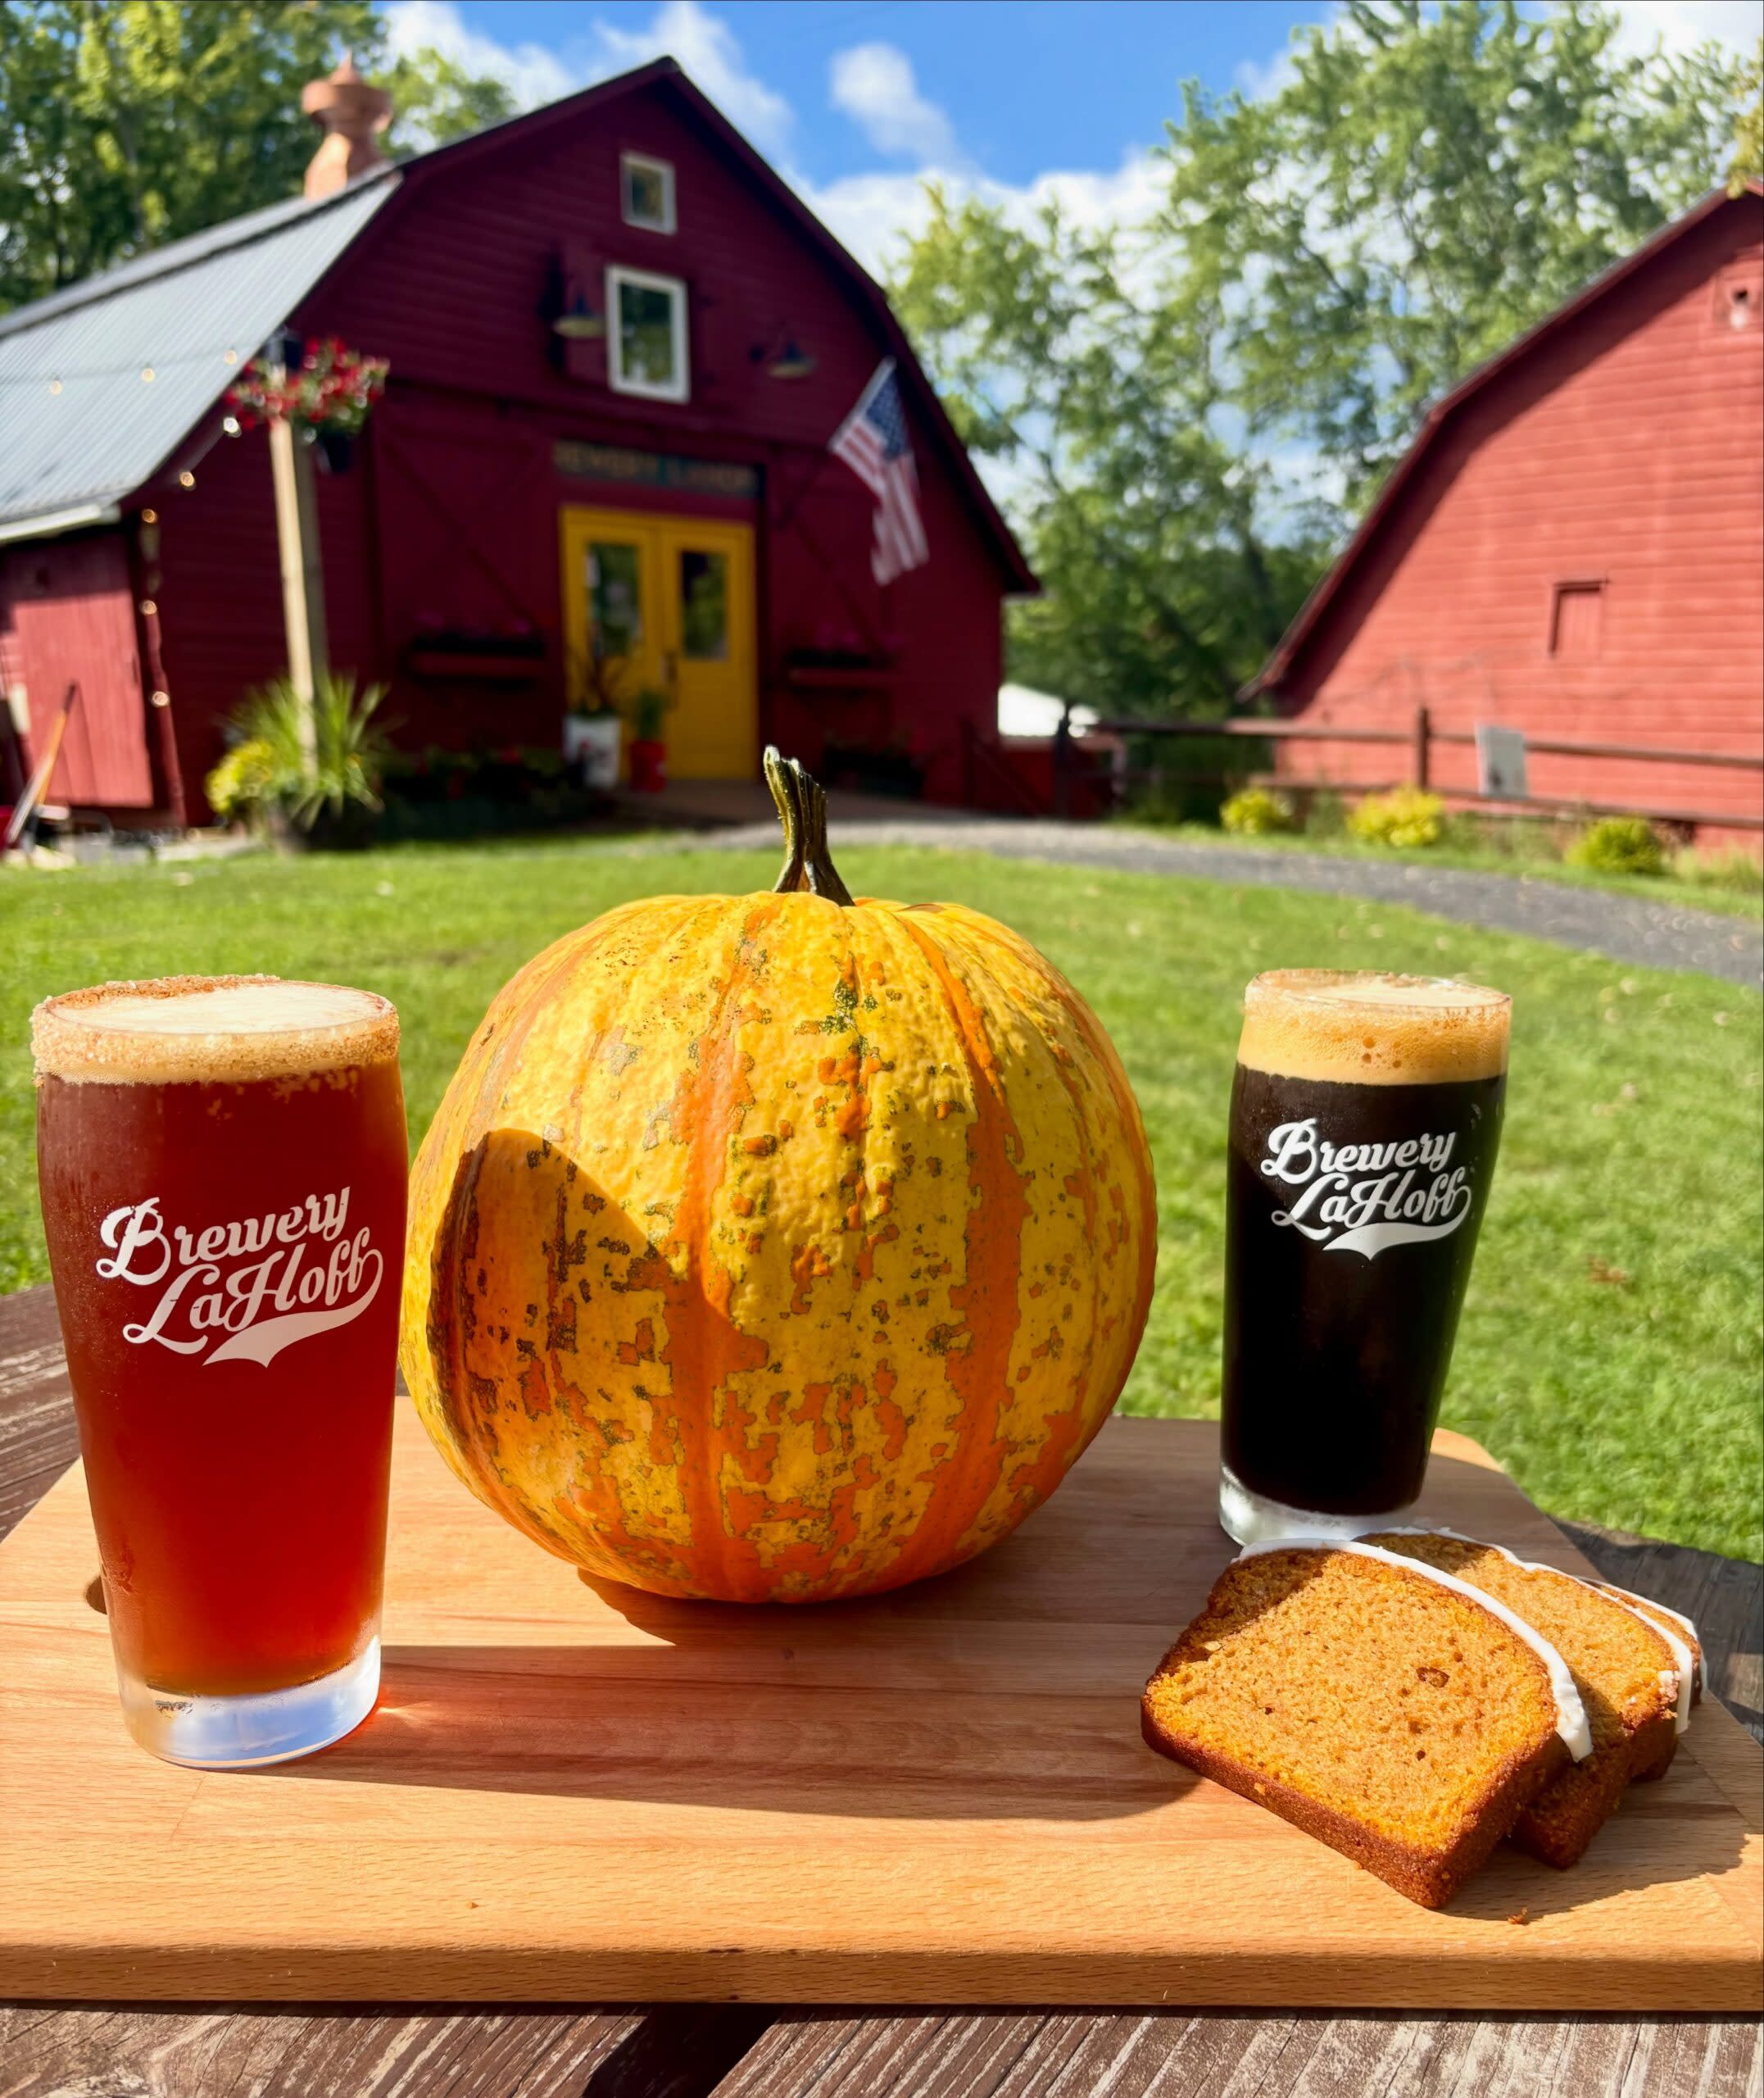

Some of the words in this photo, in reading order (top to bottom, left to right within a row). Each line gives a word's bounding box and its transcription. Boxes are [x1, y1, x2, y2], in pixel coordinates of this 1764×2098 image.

[1260, 1117, 1457, 1184] Brewery
[95, 1186, 351, 1286] Brewery
[1271, 1165, 1472, 1241] LaHoff
[122, 1226, 383, 1356] LaHoff
